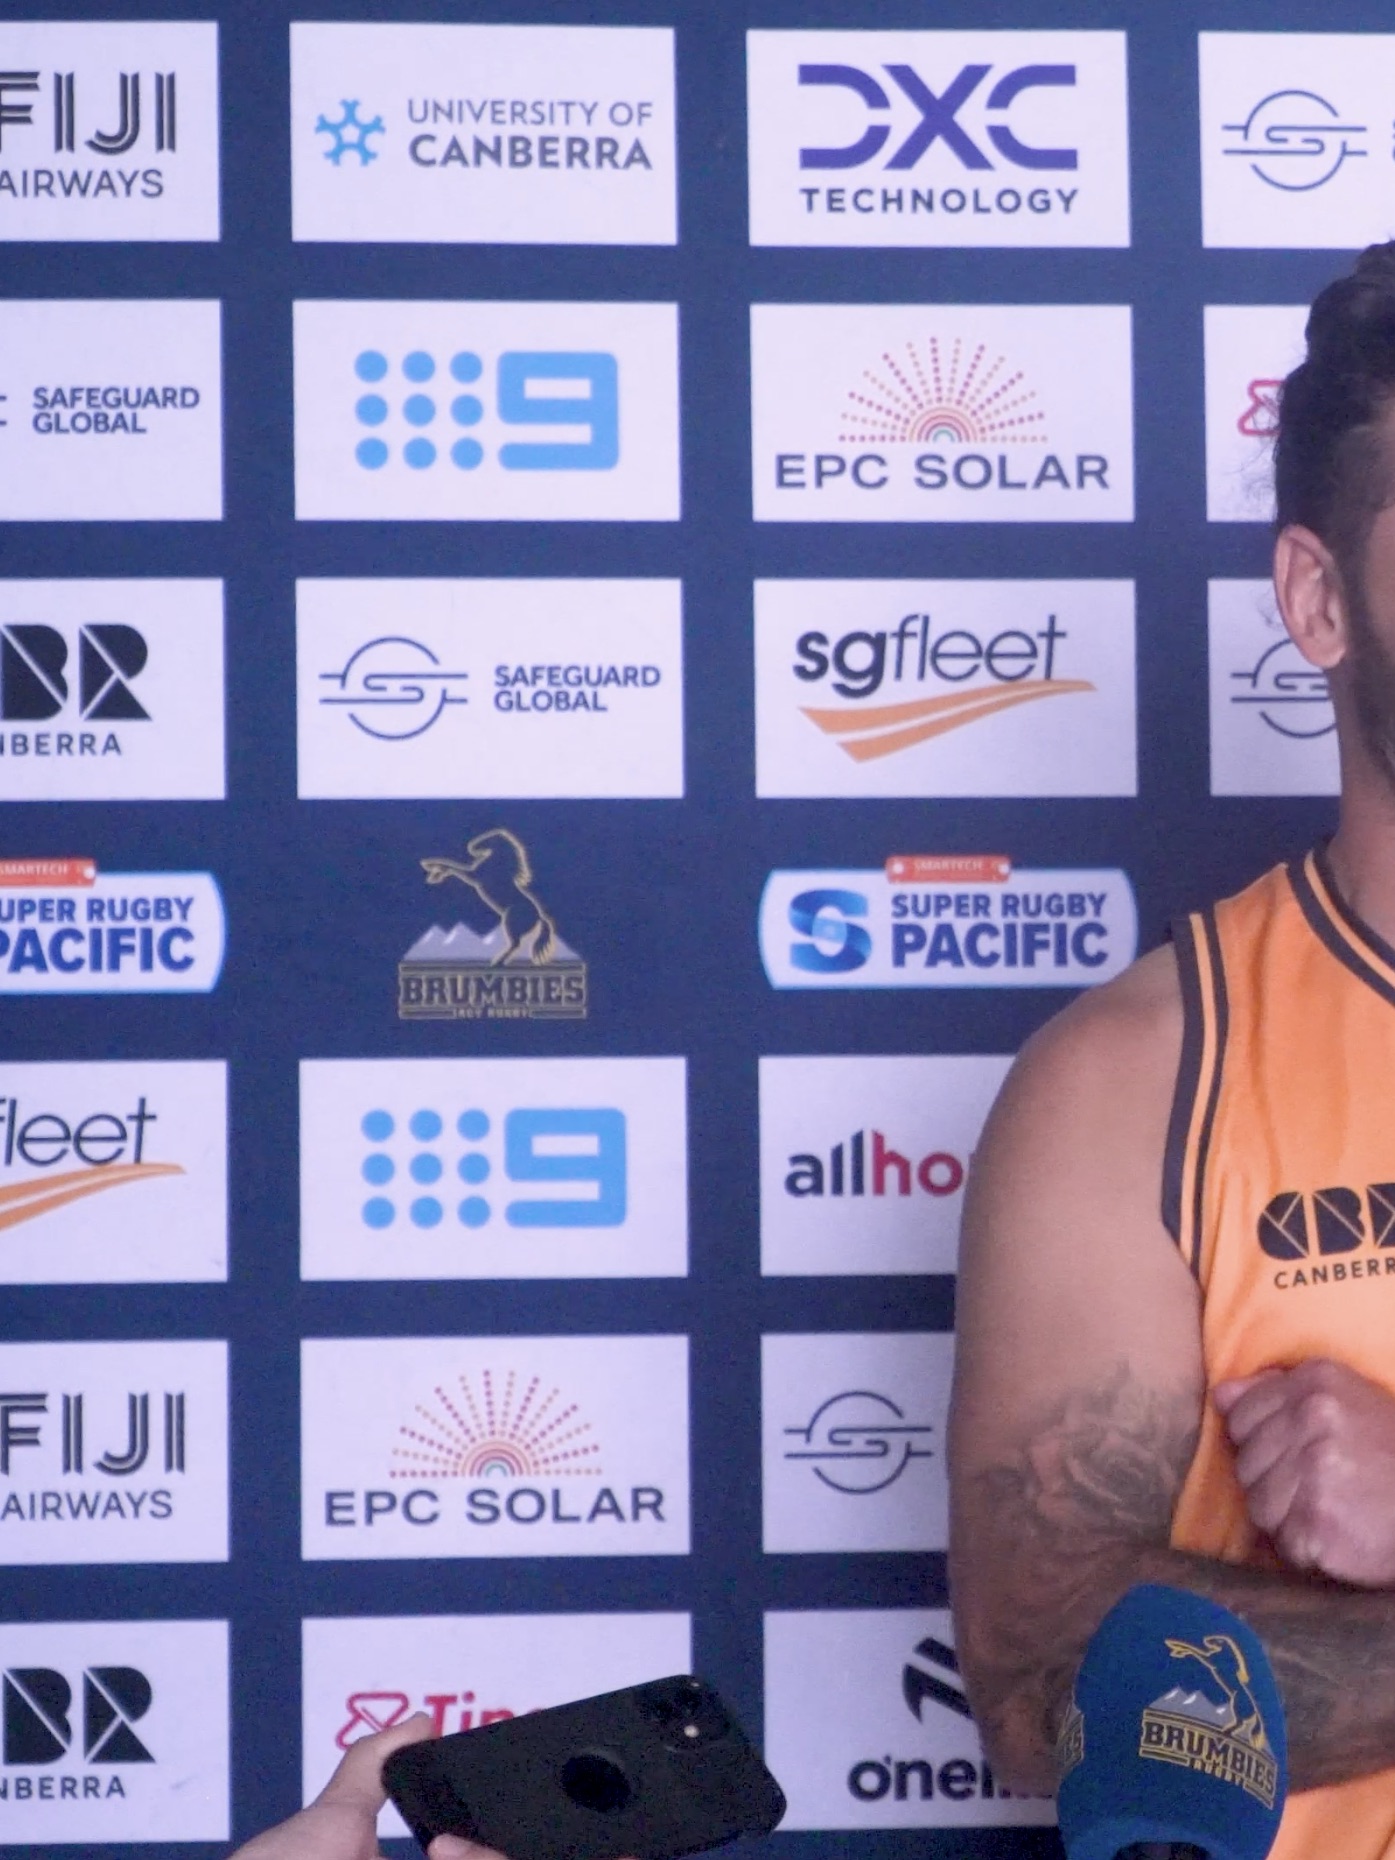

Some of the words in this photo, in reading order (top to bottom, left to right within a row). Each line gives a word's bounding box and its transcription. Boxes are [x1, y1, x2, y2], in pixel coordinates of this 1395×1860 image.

[0, 71, 176, 155] FIJI
[408, 99, 598, 125] UNIVERSITY
[609, 102, 652, 127] OF
[798, 64, 1078, 171] DXC
[409, 134, 652, 169] CANBERRA
[0, 169, 163, 198] AIRWAYS
[800, 188, 1078, 214] TECHNOLOGY
[34, 387, 200, 410] SAFEGUARD
[33, 411, 146, 434] GLOBAL
[776, 454, 888, 489] EPC
[915, 454, 1109, 490] SOLAR
[793, 614, 1067, 699] sgfleet
[495, 665, 661, 688] SAFEGUARD
[494, 688, 607, 712] GLOBAL
[0, 733, 121, 756] BERRA
[86, 897, 194, 923] RUGBY
[892, 893, 991, 918] SUPER
[1001, 893, 1107, 918] RUGBY
[892, 922, 1108, 968] PACIFIC
[402, 976, 585, 1006] BRUMBIES
[785, 1130, 964, 1200] allho
[0, 1393, 185, 1476] FIJI
[0, 1489, 172, 1520] AIRWAYS
[325, 1489, 439, 1526] EPC
[467, 1486, 665, 1524] SOLAR
[1142, 1721, 1277, 1796] BRUMBIES
